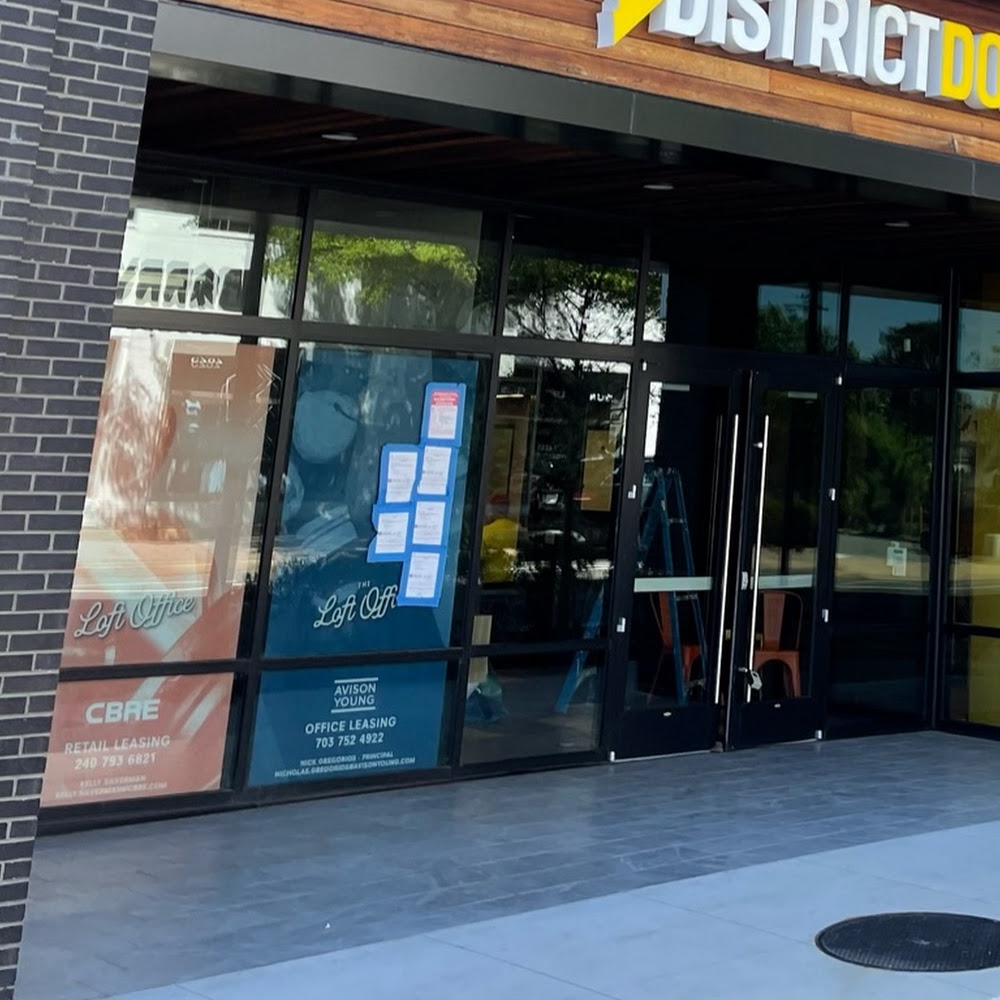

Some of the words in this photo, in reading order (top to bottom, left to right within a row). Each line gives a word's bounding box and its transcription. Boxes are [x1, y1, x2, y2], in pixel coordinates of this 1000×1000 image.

[73, 601, 127, 638] Loft
[129, 591, 195, 629] Office
[313, 594, 356, 628] Loft
[359, 584, 398, 620] Offi
[334, 682, 377, 697] AVISON
[334, 694, 376, 708] YOUNG
[85, 698, 160, 725] CBRE
[305, 720, 346, 735] OFFICE
[349, 716, 397, 732] LEASING
[64, 739, 110, 755] RETAIL
[114, 735, 171, 751] LEASING
[315, 736, 334, 749] 703
[338, 734, 356, 746] 752
[359, 732, 385, 744] 4922
[74, 758, 97, 771] 240
[102, 755, 124, 767] 793
